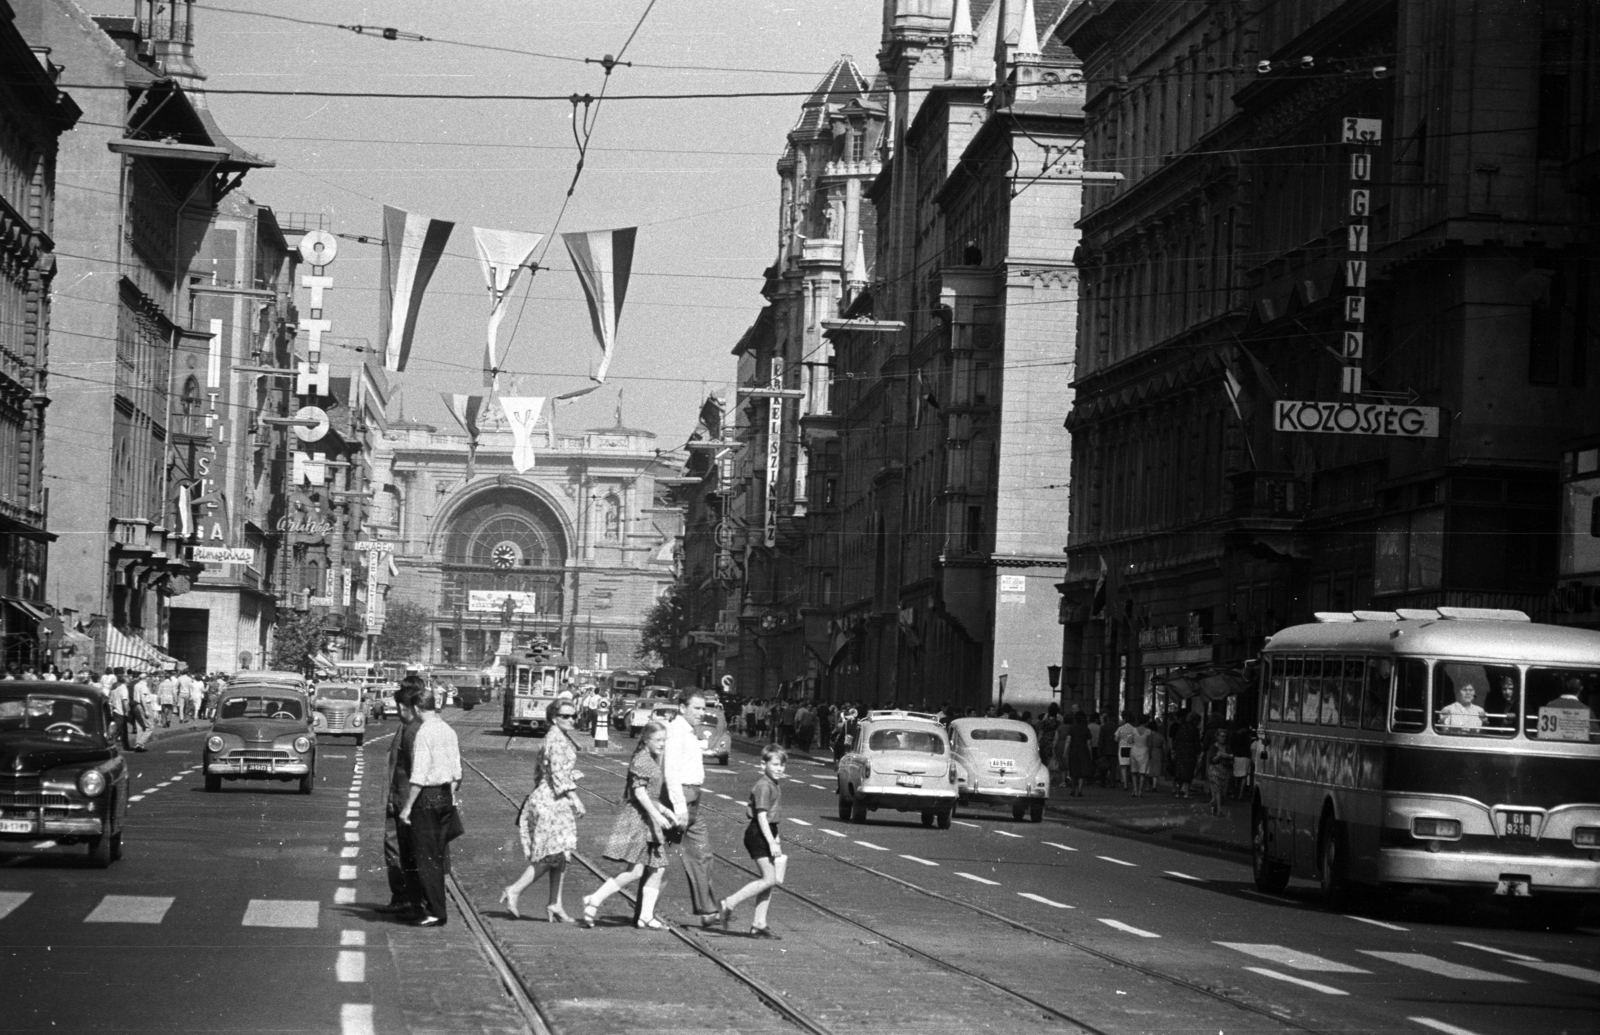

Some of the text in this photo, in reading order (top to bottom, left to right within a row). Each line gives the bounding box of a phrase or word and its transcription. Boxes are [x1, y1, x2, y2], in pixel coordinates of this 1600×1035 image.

[293, 230, 338, 486] OTTHON
[1279, 401, 1424, 434] KÖZÖSSÉG
[1541, 714, 1557, 732] 39
